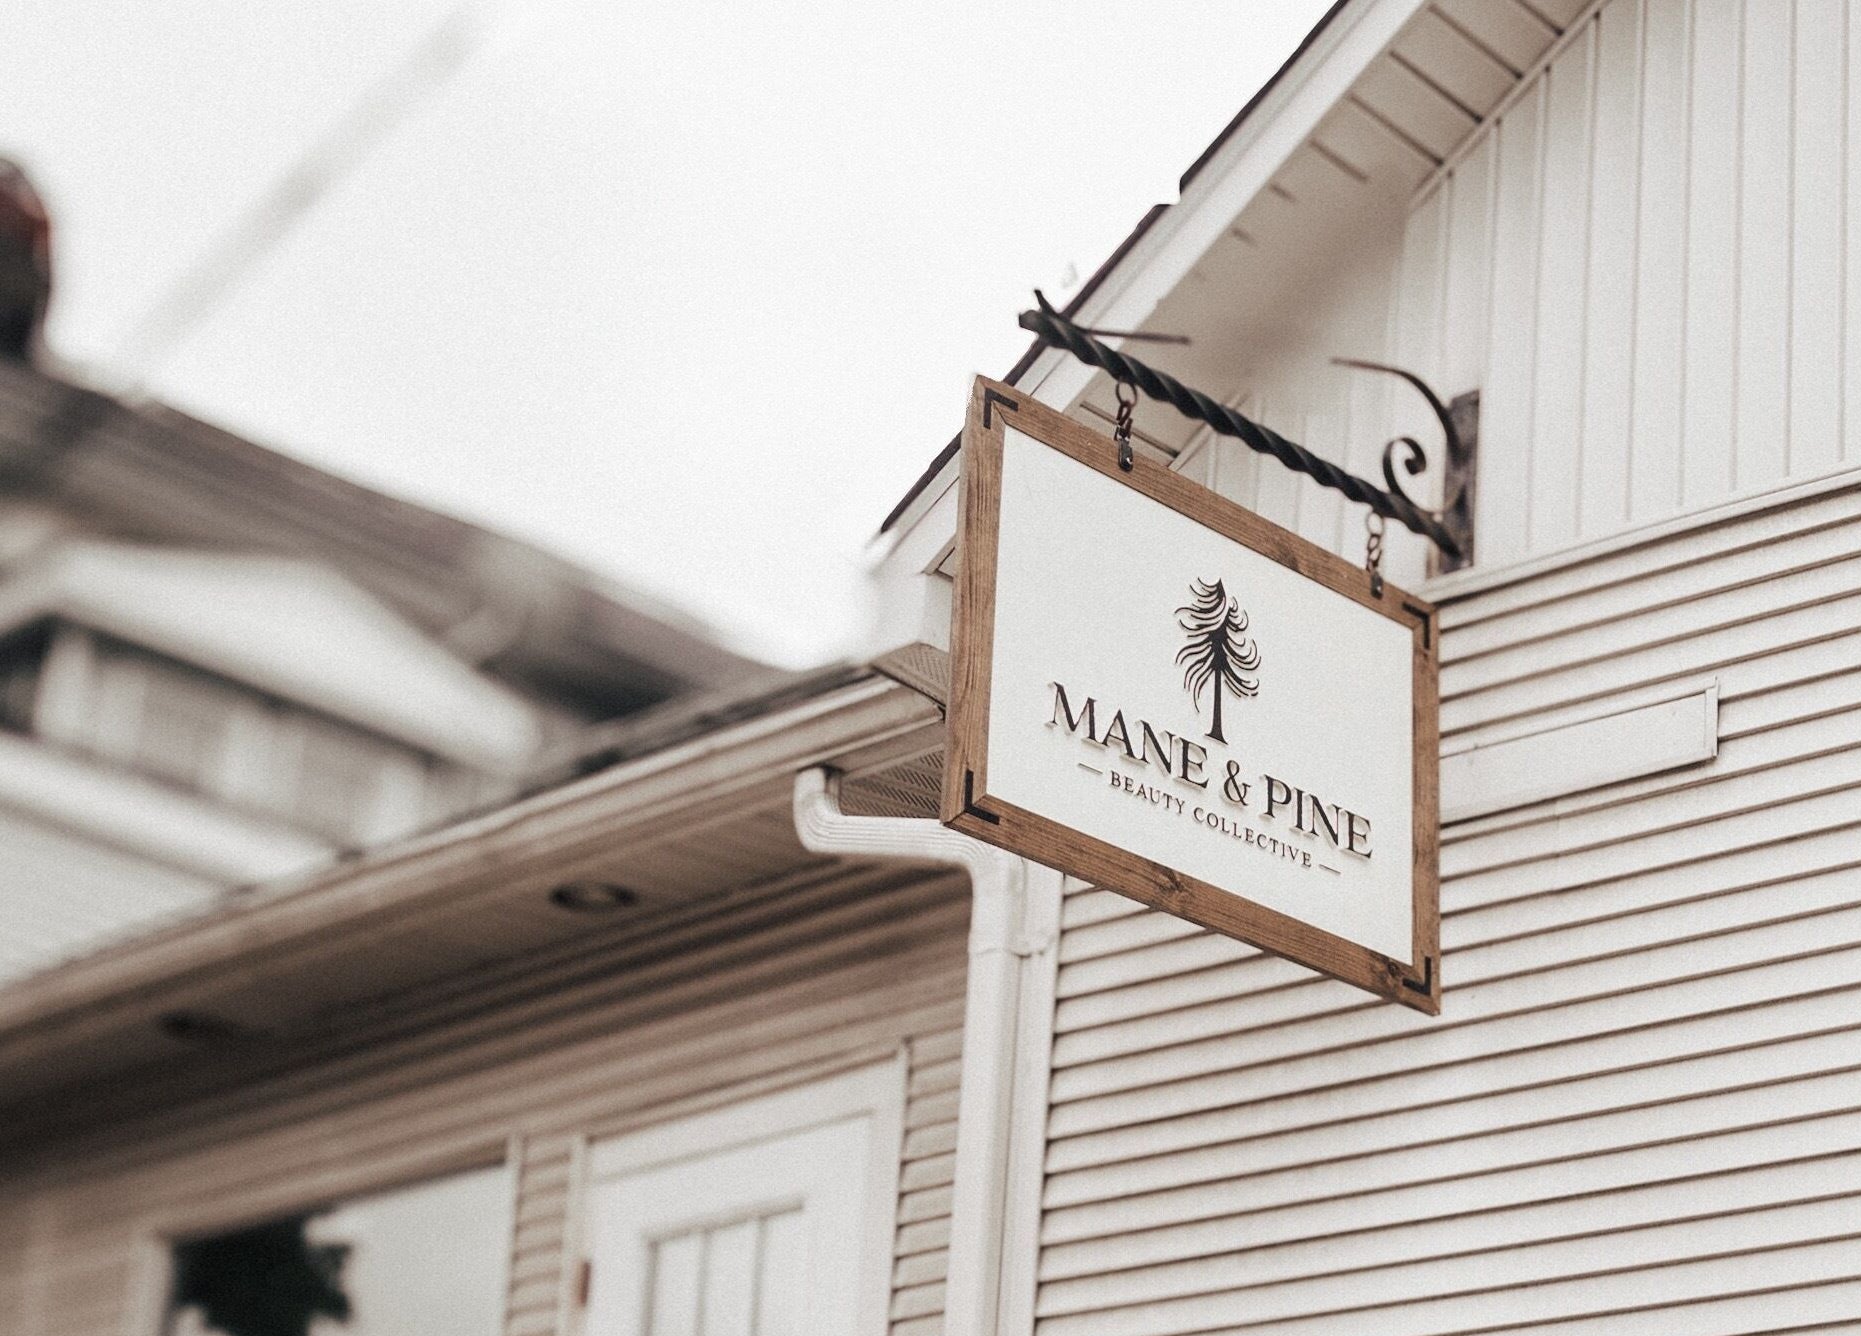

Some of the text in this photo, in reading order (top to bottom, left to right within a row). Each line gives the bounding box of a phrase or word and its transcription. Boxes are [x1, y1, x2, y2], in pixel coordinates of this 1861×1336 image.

[1052, 681, 1372, 859] MANE & PINE
[1110, 770, 1311, 868] BEAUTY COLLECTIVE
